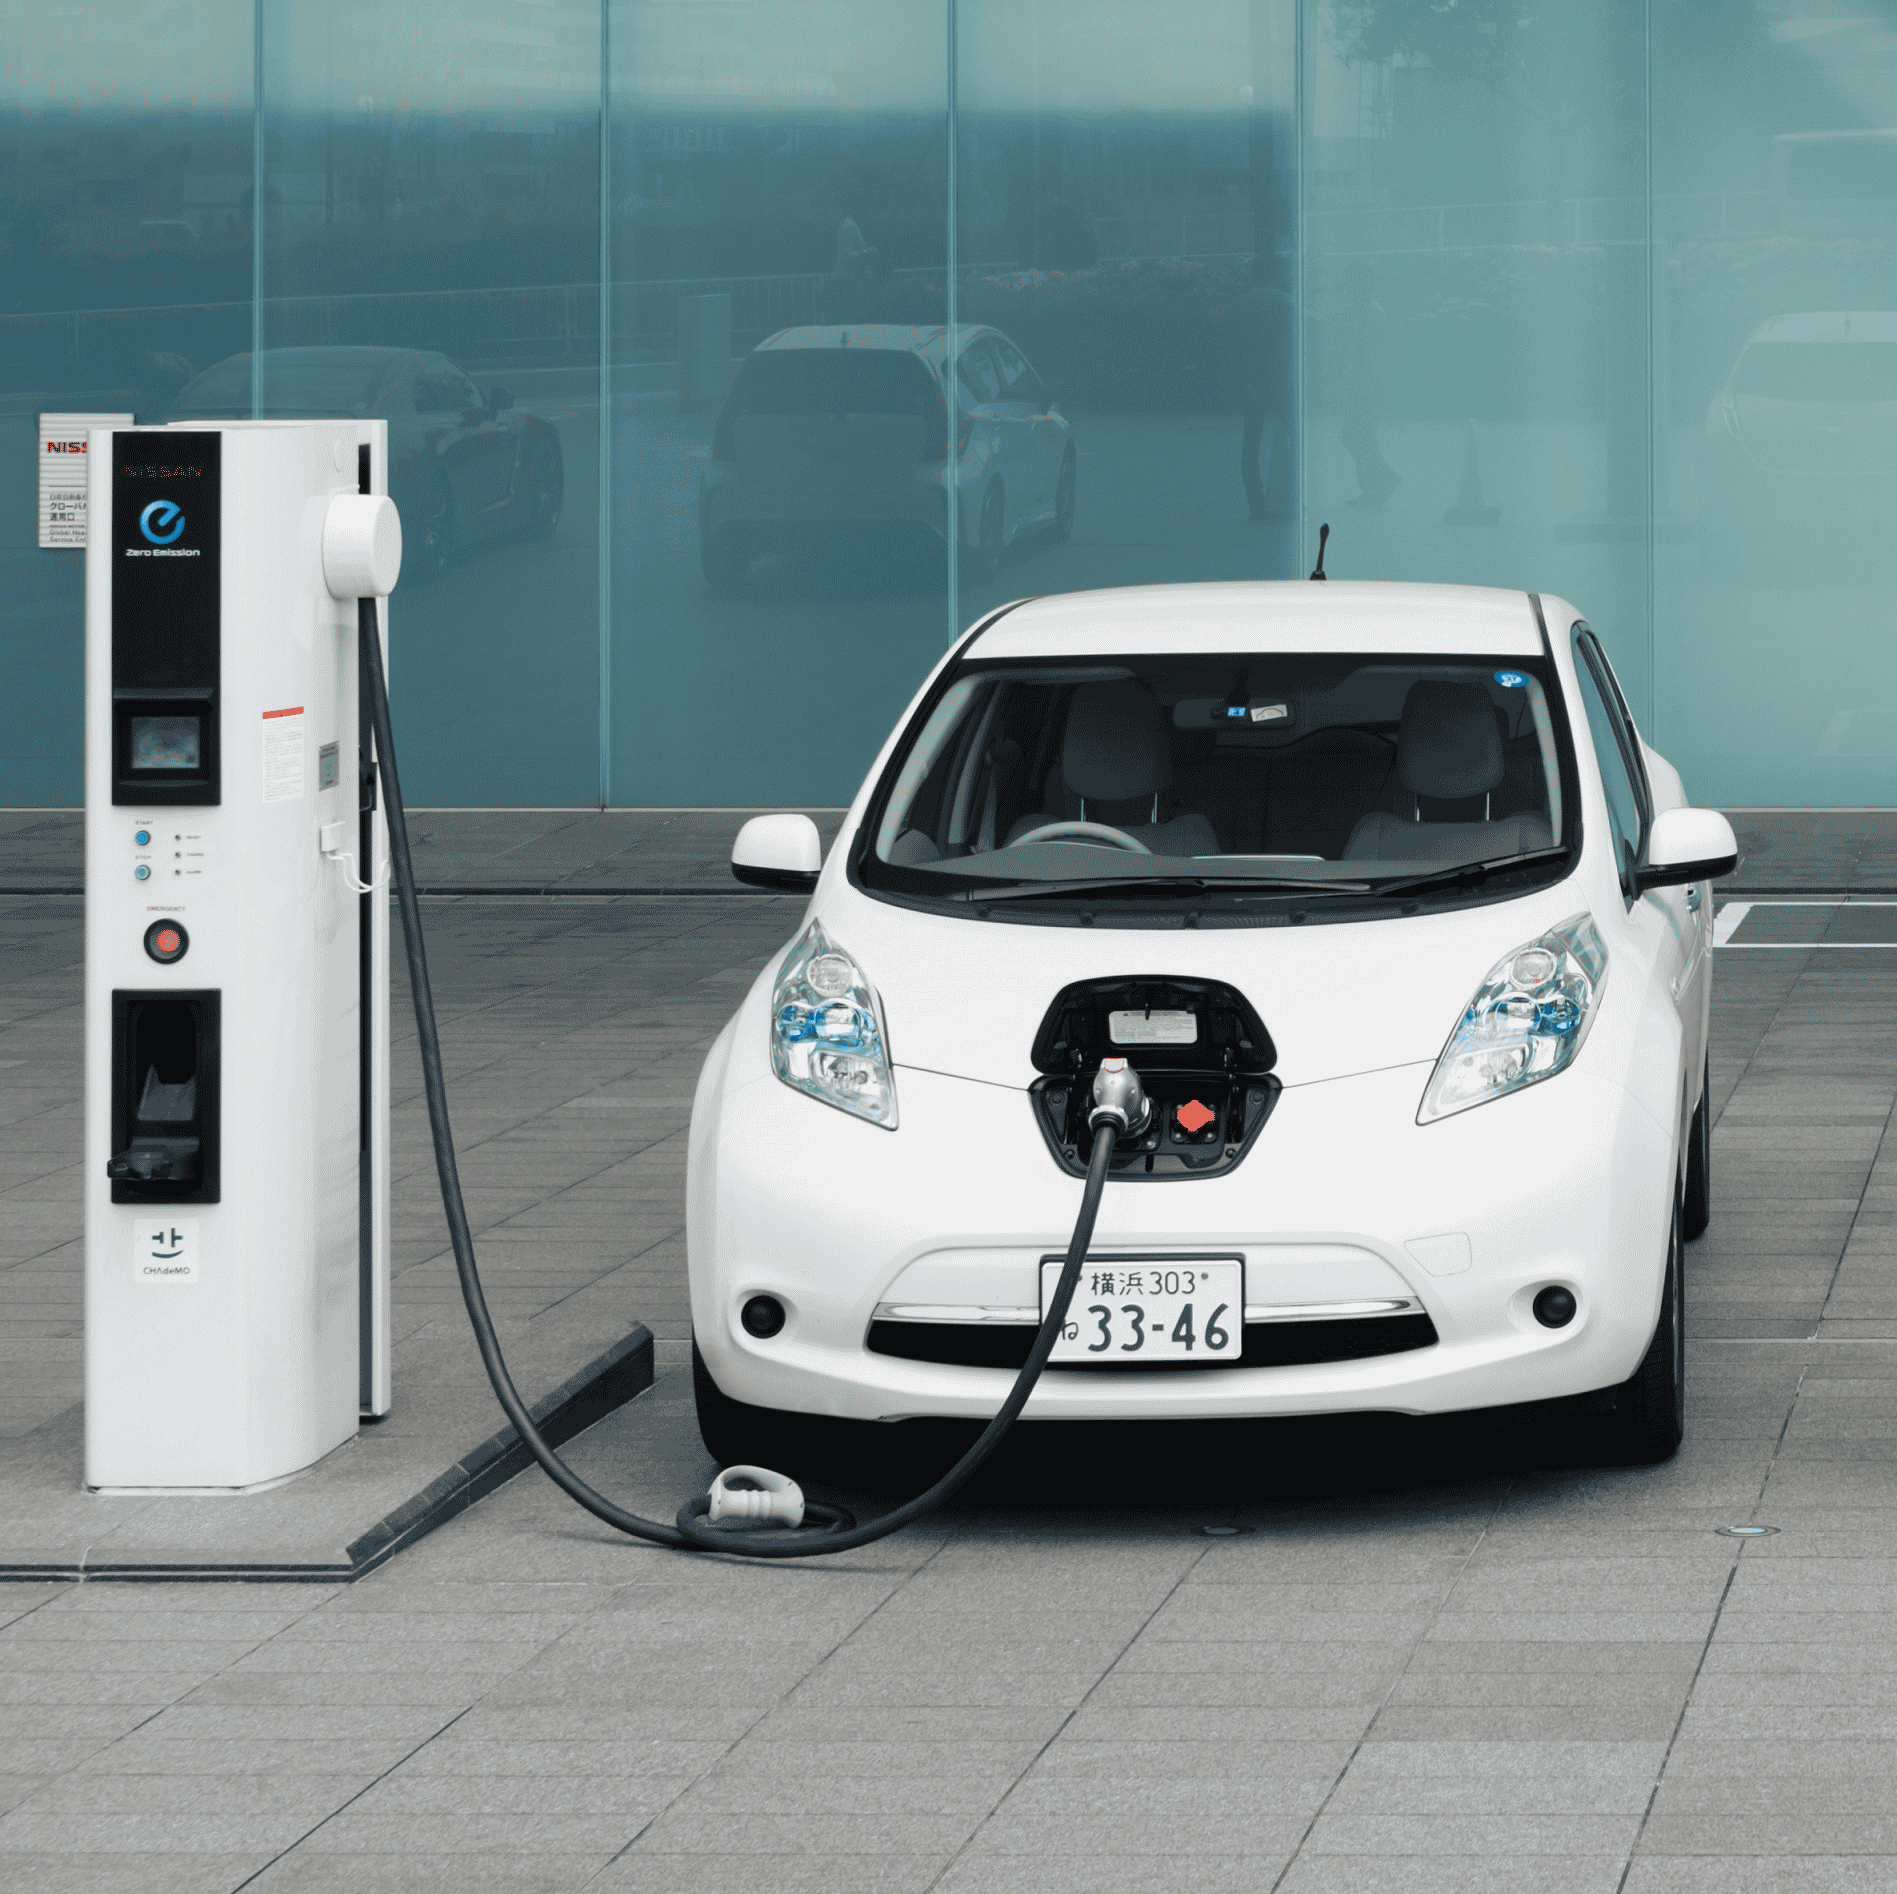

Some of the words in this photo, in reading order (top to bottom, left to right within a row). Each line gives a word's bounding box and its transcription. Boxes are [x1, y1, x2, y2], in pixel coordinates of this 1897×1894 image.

[125, 466, 202, 478] NISSAN
[126, 548, 152, 557] Zero
[153, 548, 201, 557] Emission
[1087, 1303, 1229, 1352] 33-46
